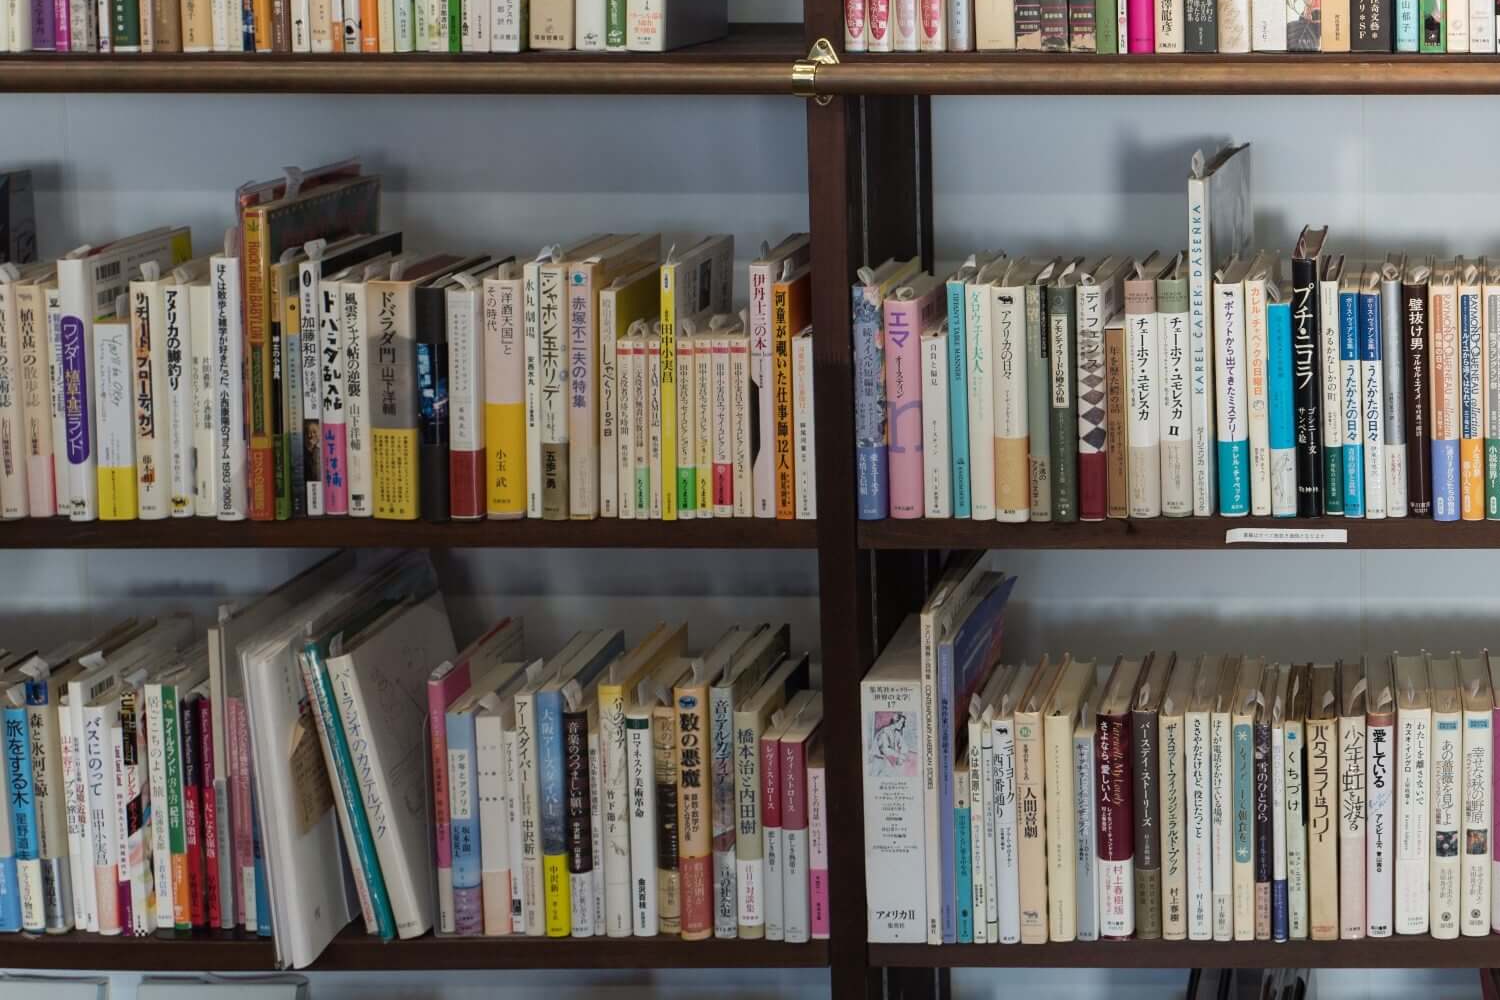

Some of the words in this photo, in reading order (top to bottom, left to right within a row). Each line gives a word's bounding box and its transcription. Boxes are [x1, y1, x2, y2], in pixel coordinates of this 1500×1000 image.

[166, 290, 179, 391] アメリカの鱒釣り
[301, 316, 316, 368] 加藤和彦
[571, 297, 586, 408] 赤塚不二夫の特集
[888, 311, 909, 349] エマ
[1293, 282, 1316, 391] プチ・ニコラ
[1408, 297, 1424, 352] 壁抜け男
[1346, 364, 1358, 442] うたかたの日々
[1367, 364, 1379, 442] うたかたの日々
[679, 712, 702, 789] 数の悪魔
[736, 728, 757, 836] 橋本治と内田樹
[1286, 750, 1302, 812] くちづけ
[1372, 728, 1388, 790] 愛している
[1024, 787, 1039, 840] 人間喜劇
